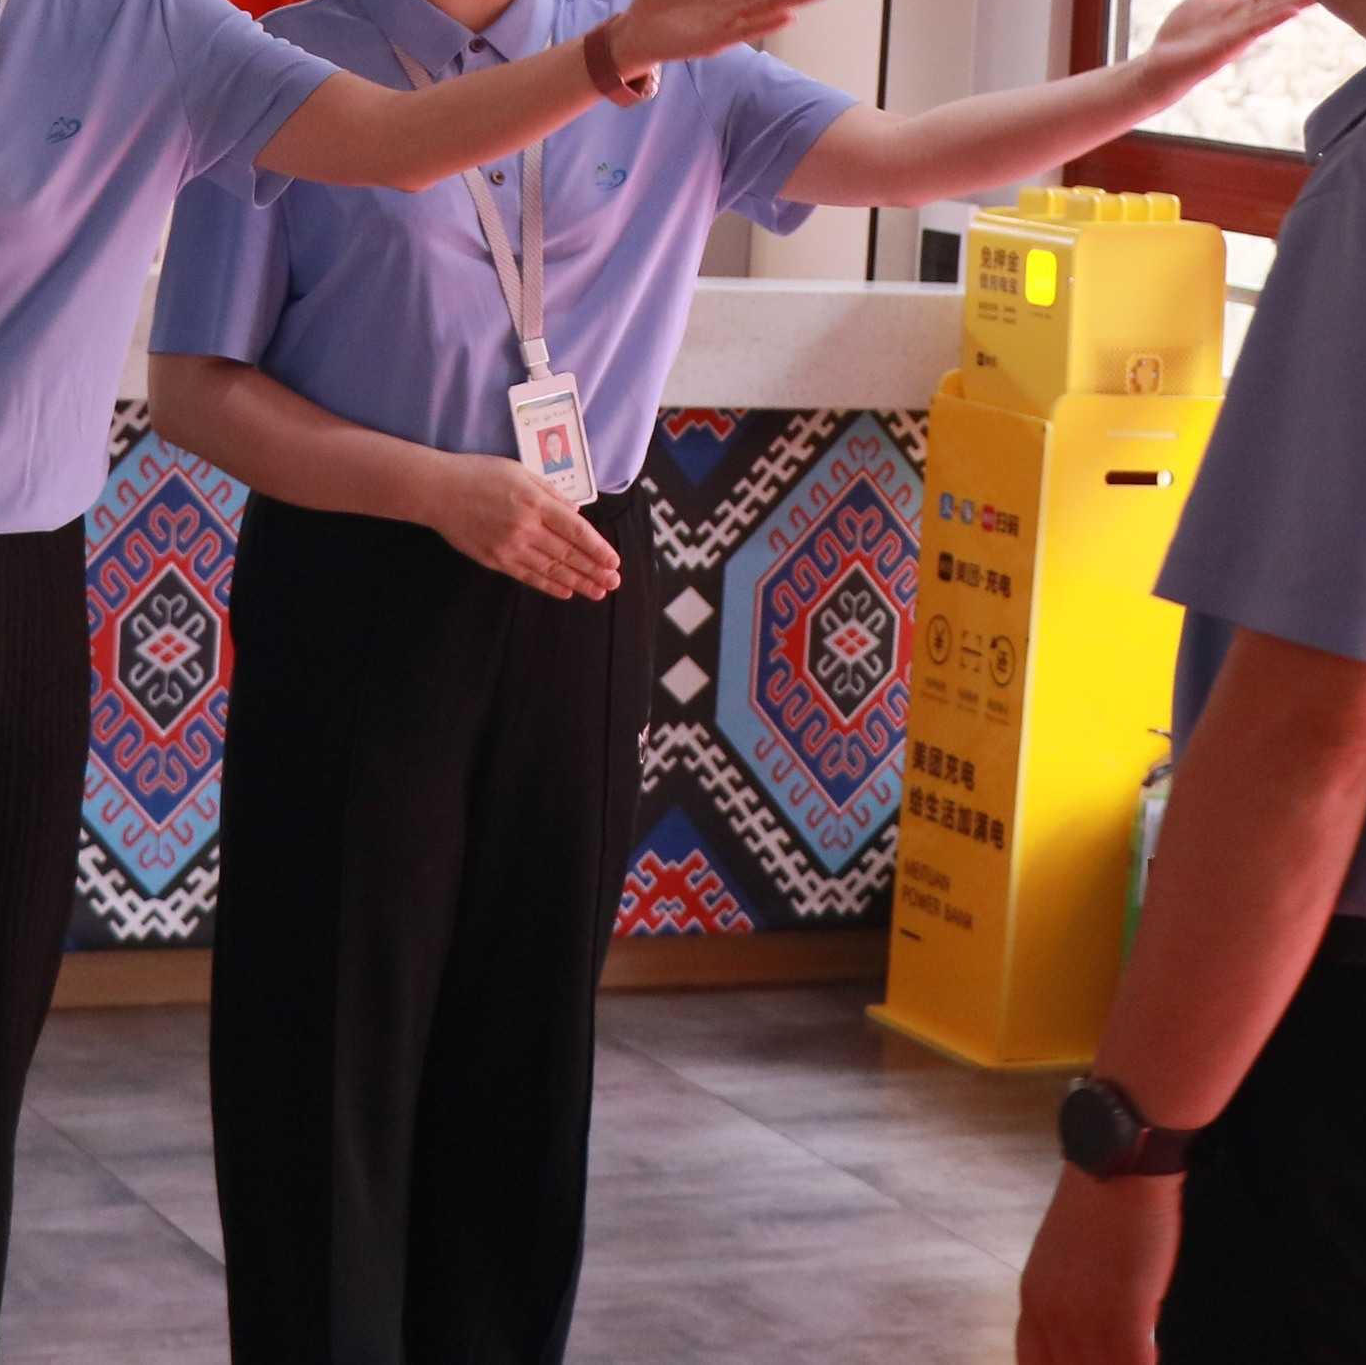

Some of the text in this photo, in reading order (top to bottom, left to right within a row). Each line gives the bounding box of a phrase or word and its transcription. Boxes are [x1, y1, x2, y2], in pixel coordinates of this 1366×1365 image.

[912, 740, 976, 793] 美团充电
[909, 785, 1005, 851] 给生活加满电
